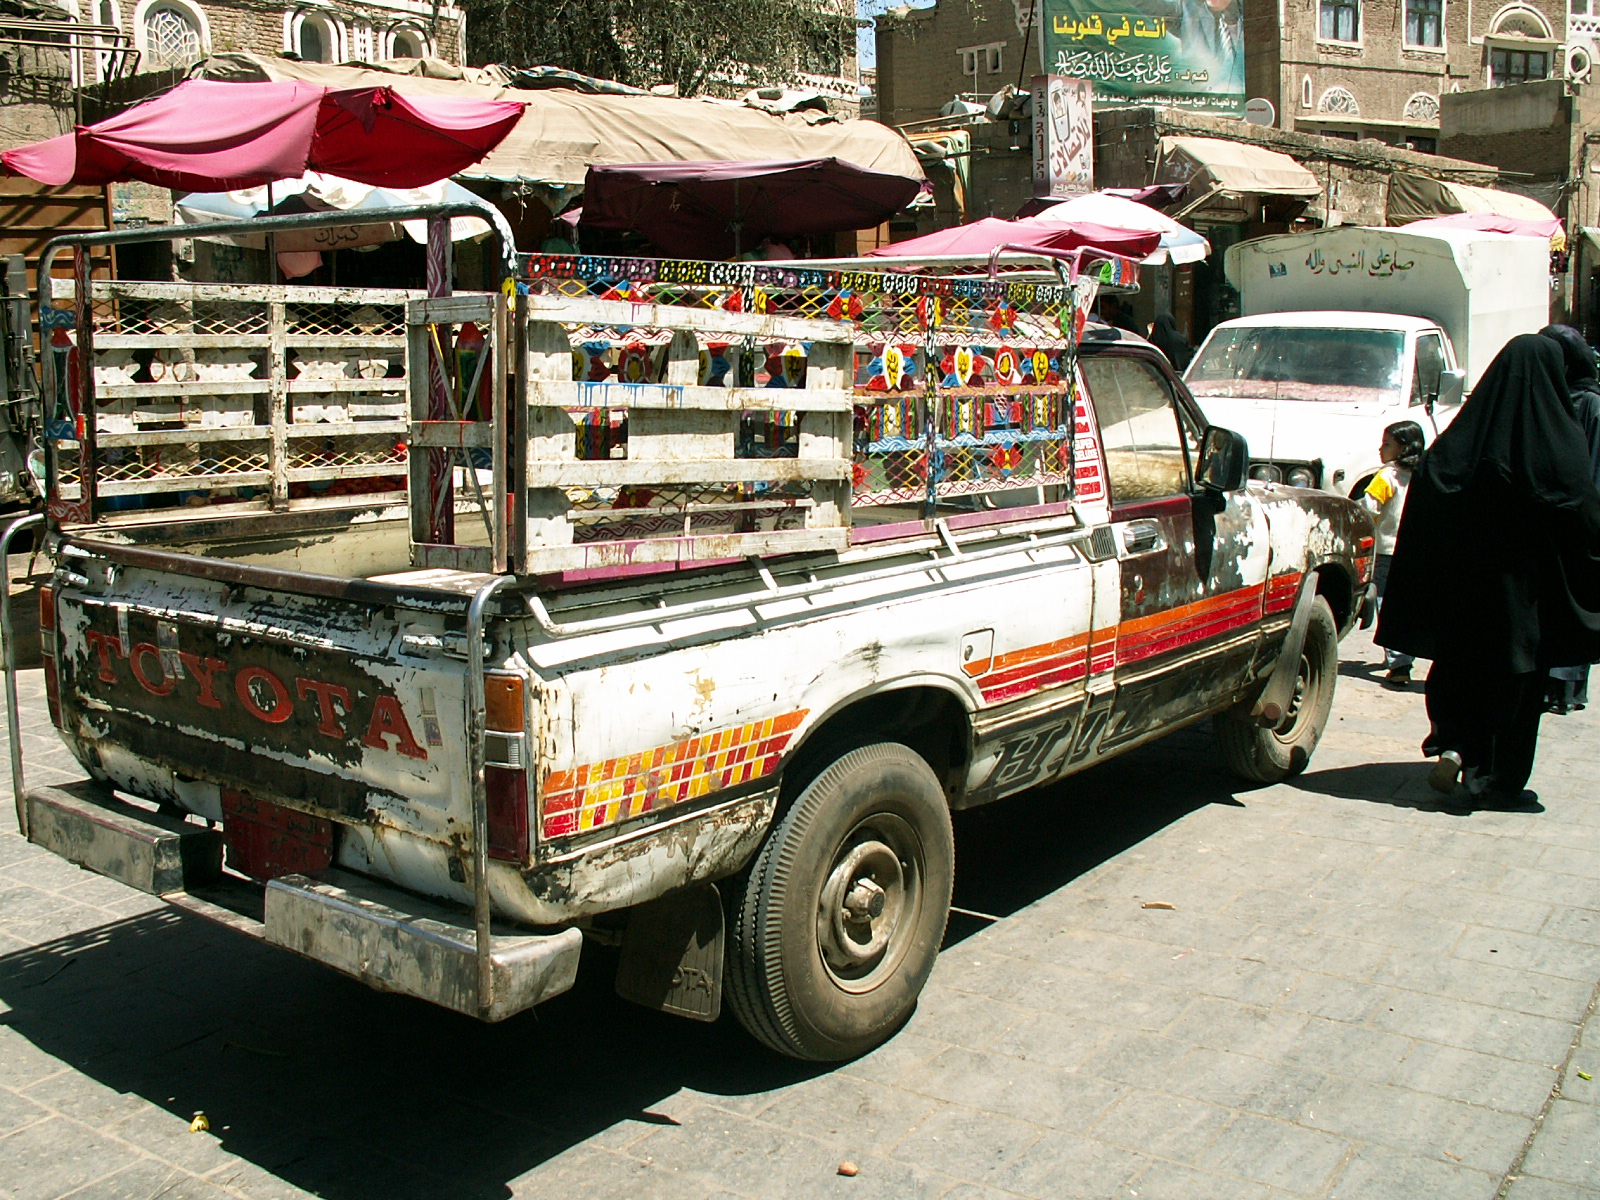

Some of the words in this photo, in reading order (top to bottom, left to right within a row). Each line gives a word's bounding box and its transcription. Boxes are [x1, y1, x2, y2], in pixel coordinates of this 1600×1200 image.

[1053, 14, 1103, 41] قلوبنا
[1106, 16, 1130, 45] في
[86, 630, 428, 761] TOYOTA
